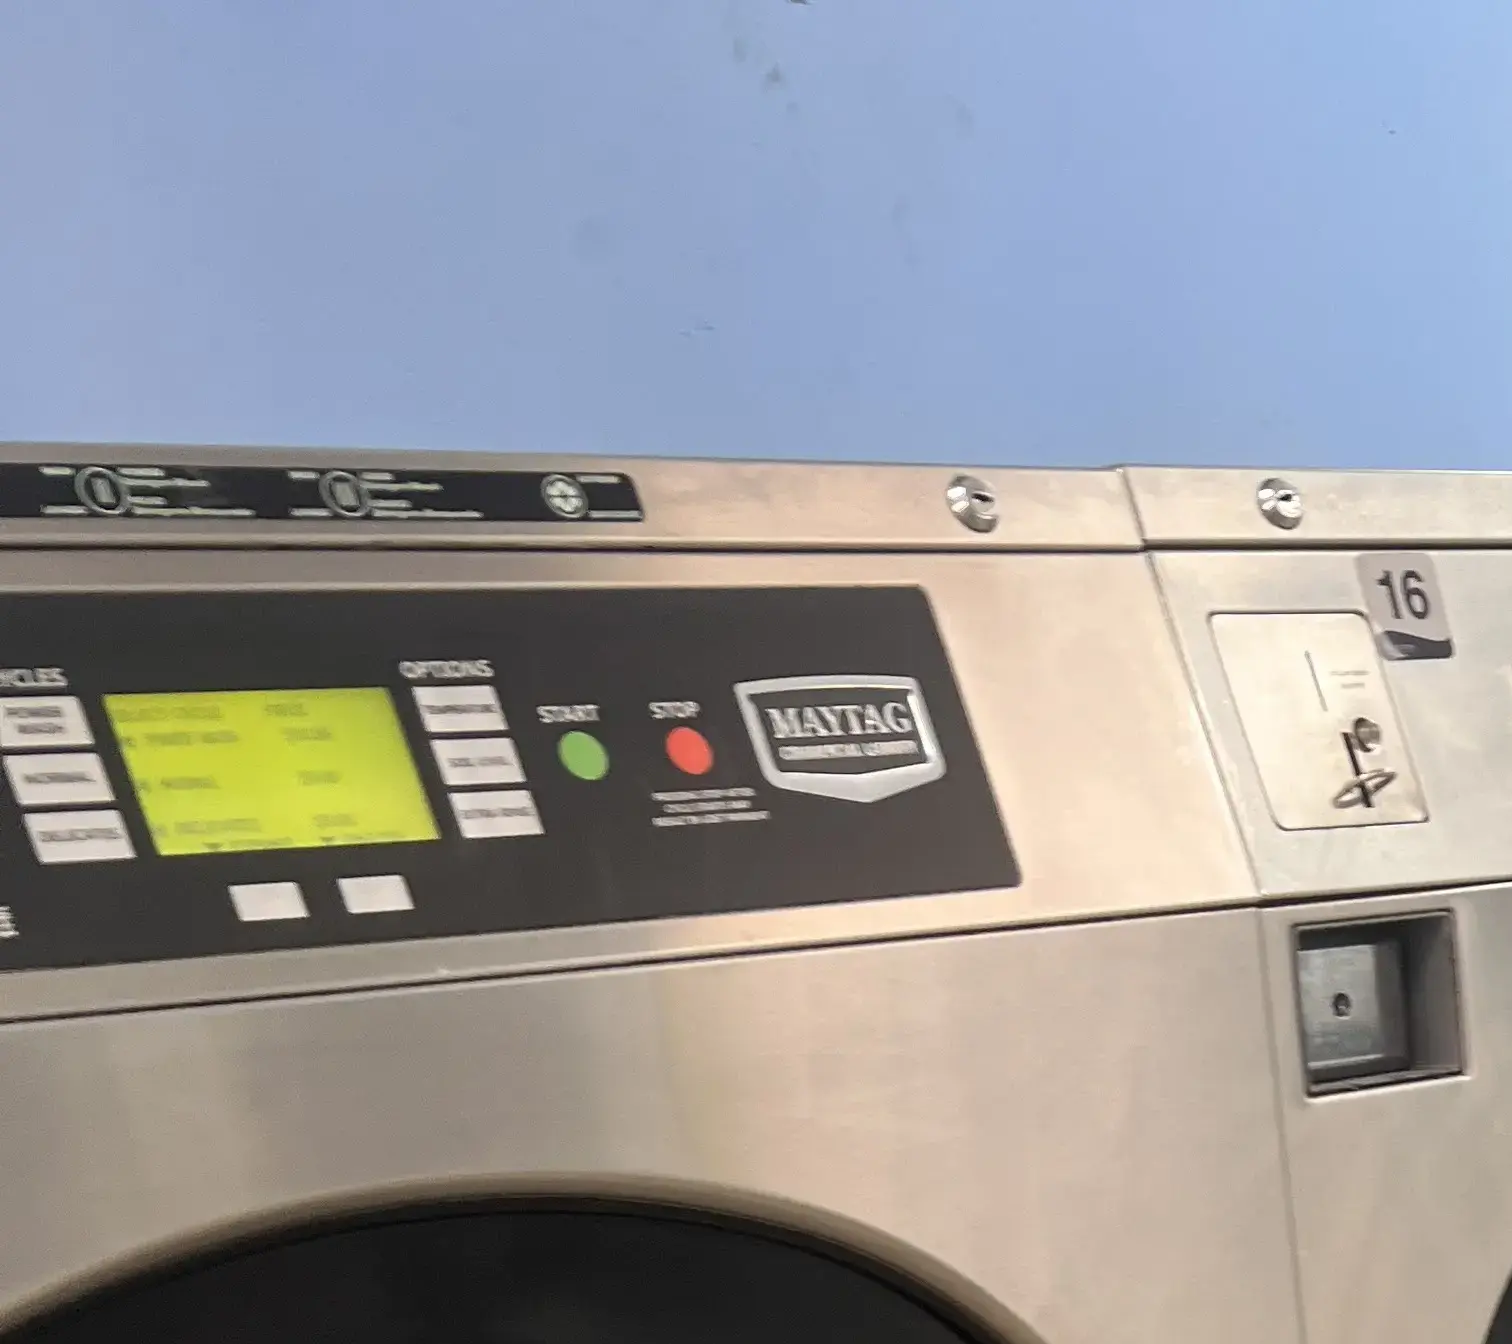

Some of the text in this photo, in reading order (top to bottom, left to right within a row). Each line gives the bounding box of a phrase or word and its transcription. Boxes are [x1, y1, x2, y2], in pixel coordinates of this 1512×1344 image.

[1376, 570, 1430, 621] 16
[398, 659, 495, 679] OPTIONS
[536, 704, 600, 724] START
[649, 701, 700, 719] STOP
[764, 701, 914, 739] MAYTAG
